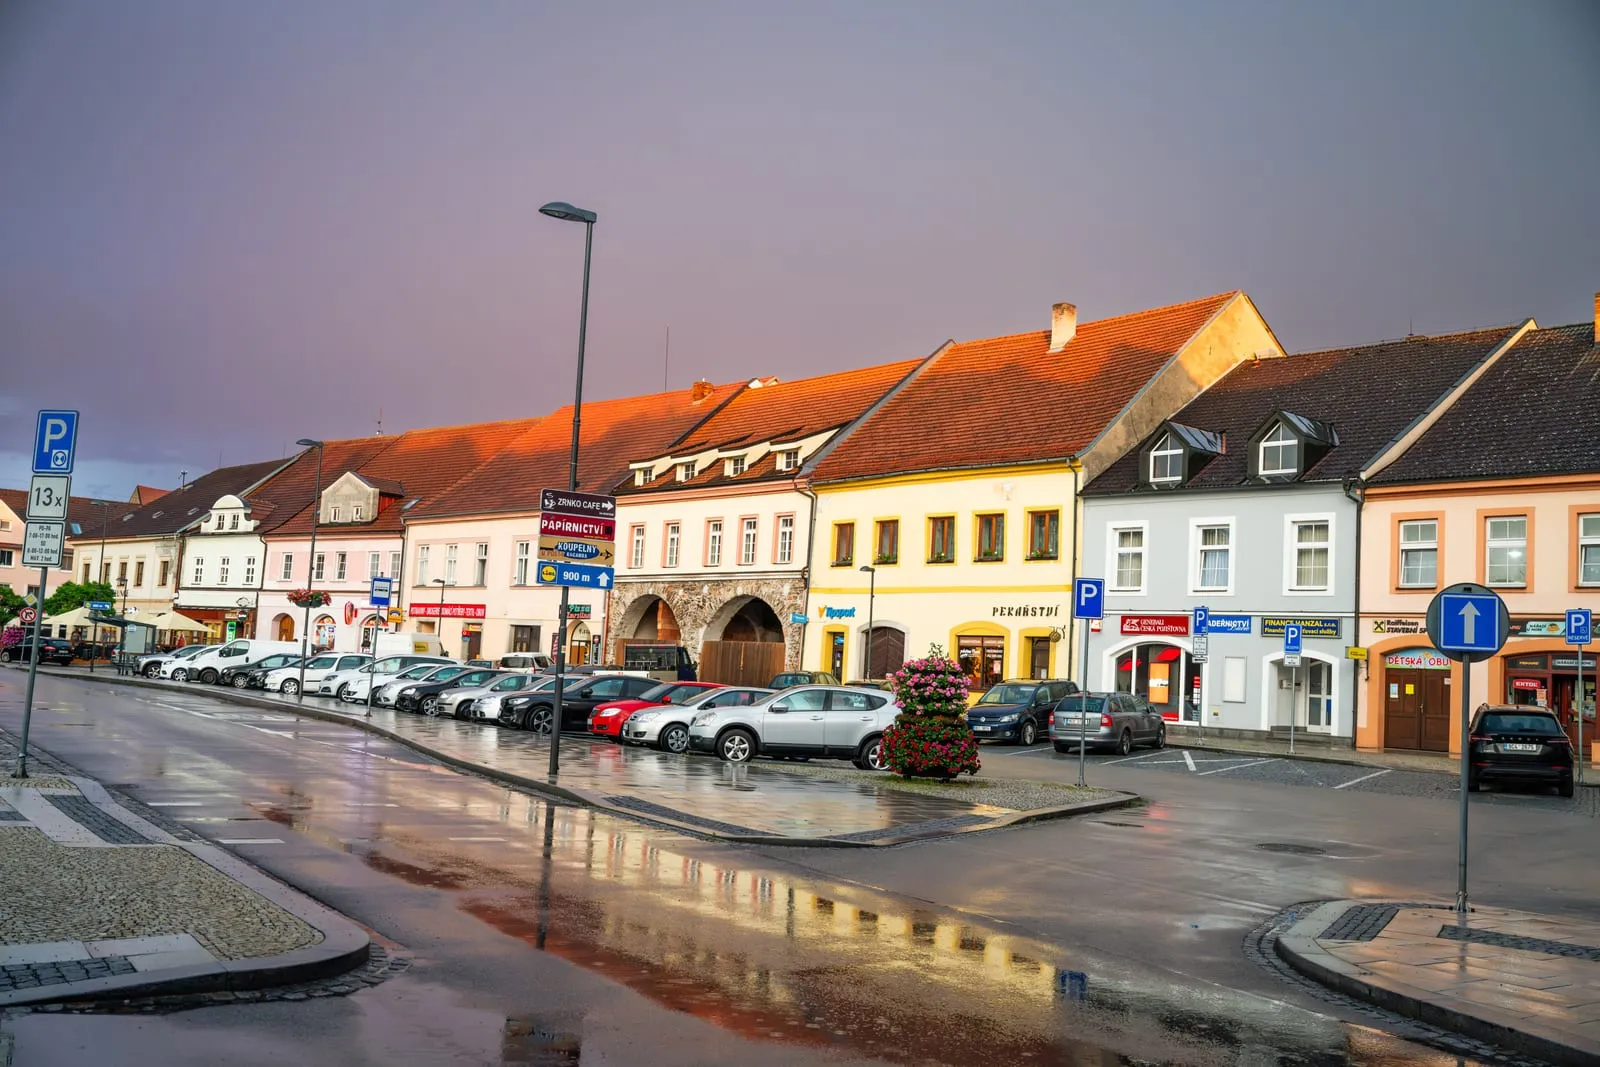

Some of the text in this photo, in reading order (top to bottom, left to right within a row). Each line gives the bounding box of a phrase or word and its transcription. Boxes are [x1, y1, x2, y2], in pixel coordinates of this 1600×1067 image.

[43, 418, 67, 453] P
[558, 498, 600, 510] ZRNKO CAFE
[542, 518, 604, 535] PAPÍRNICTVÍ
[558, 542, 597, 554] KOUPELNY
[563, 571, 590, 582] 900 m
[1080, 583, 1098, 606] P
[992, 604, 1060, 617] PEKAŘSTVÍ
[1196, 610, 1205, 626] P
[1208, 619, 1250, 627] ADEŘNICTVÍ
[1571, 614, 1585, 634] P
[1288, 628, 1298, 644] P
[1388, 655, 1422, 665] DĚTSKÁ
